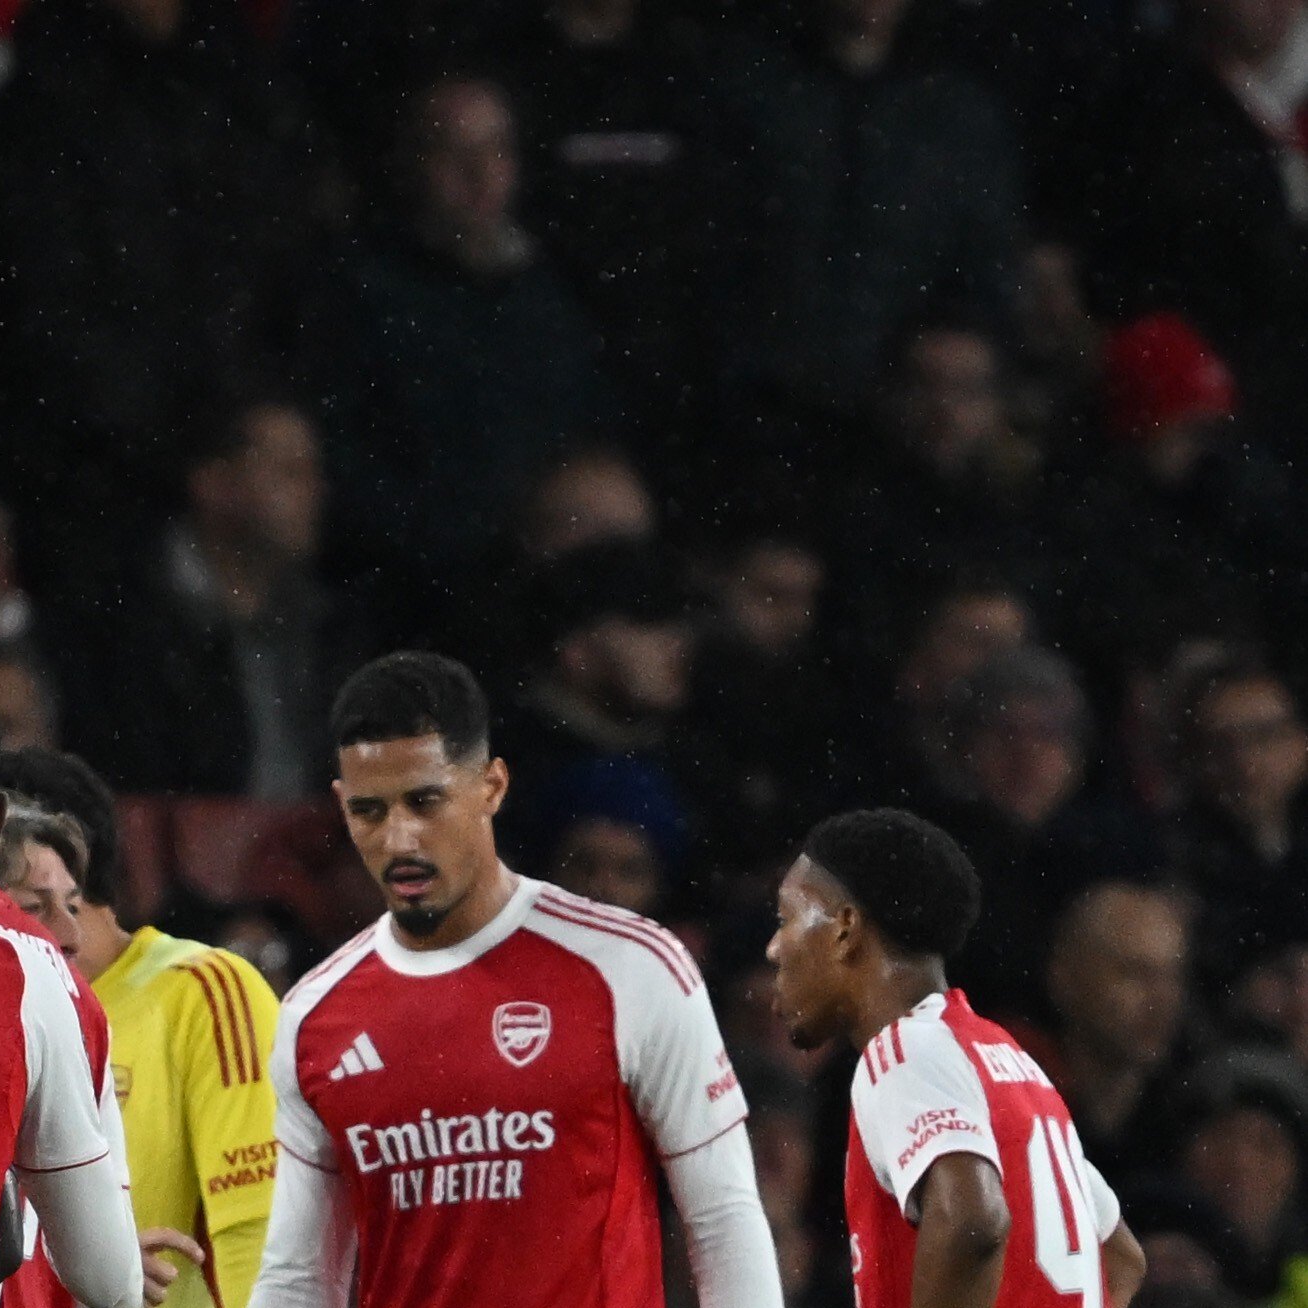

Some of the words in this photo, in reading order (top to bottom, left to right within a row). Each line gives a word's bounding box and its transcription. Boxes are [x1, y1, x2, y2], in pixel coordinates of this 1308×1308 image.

[345, 1106, 555, 1174] Emirates
[897, 1119, 984, 1171] RWANDA
[906, 1107, 958, 1135] VISIT
[222, 1138, 278, 1167] VISIT
[391, 1168, 424, 1210] FLY
[431, 1159, 523, 1205] BETTER
